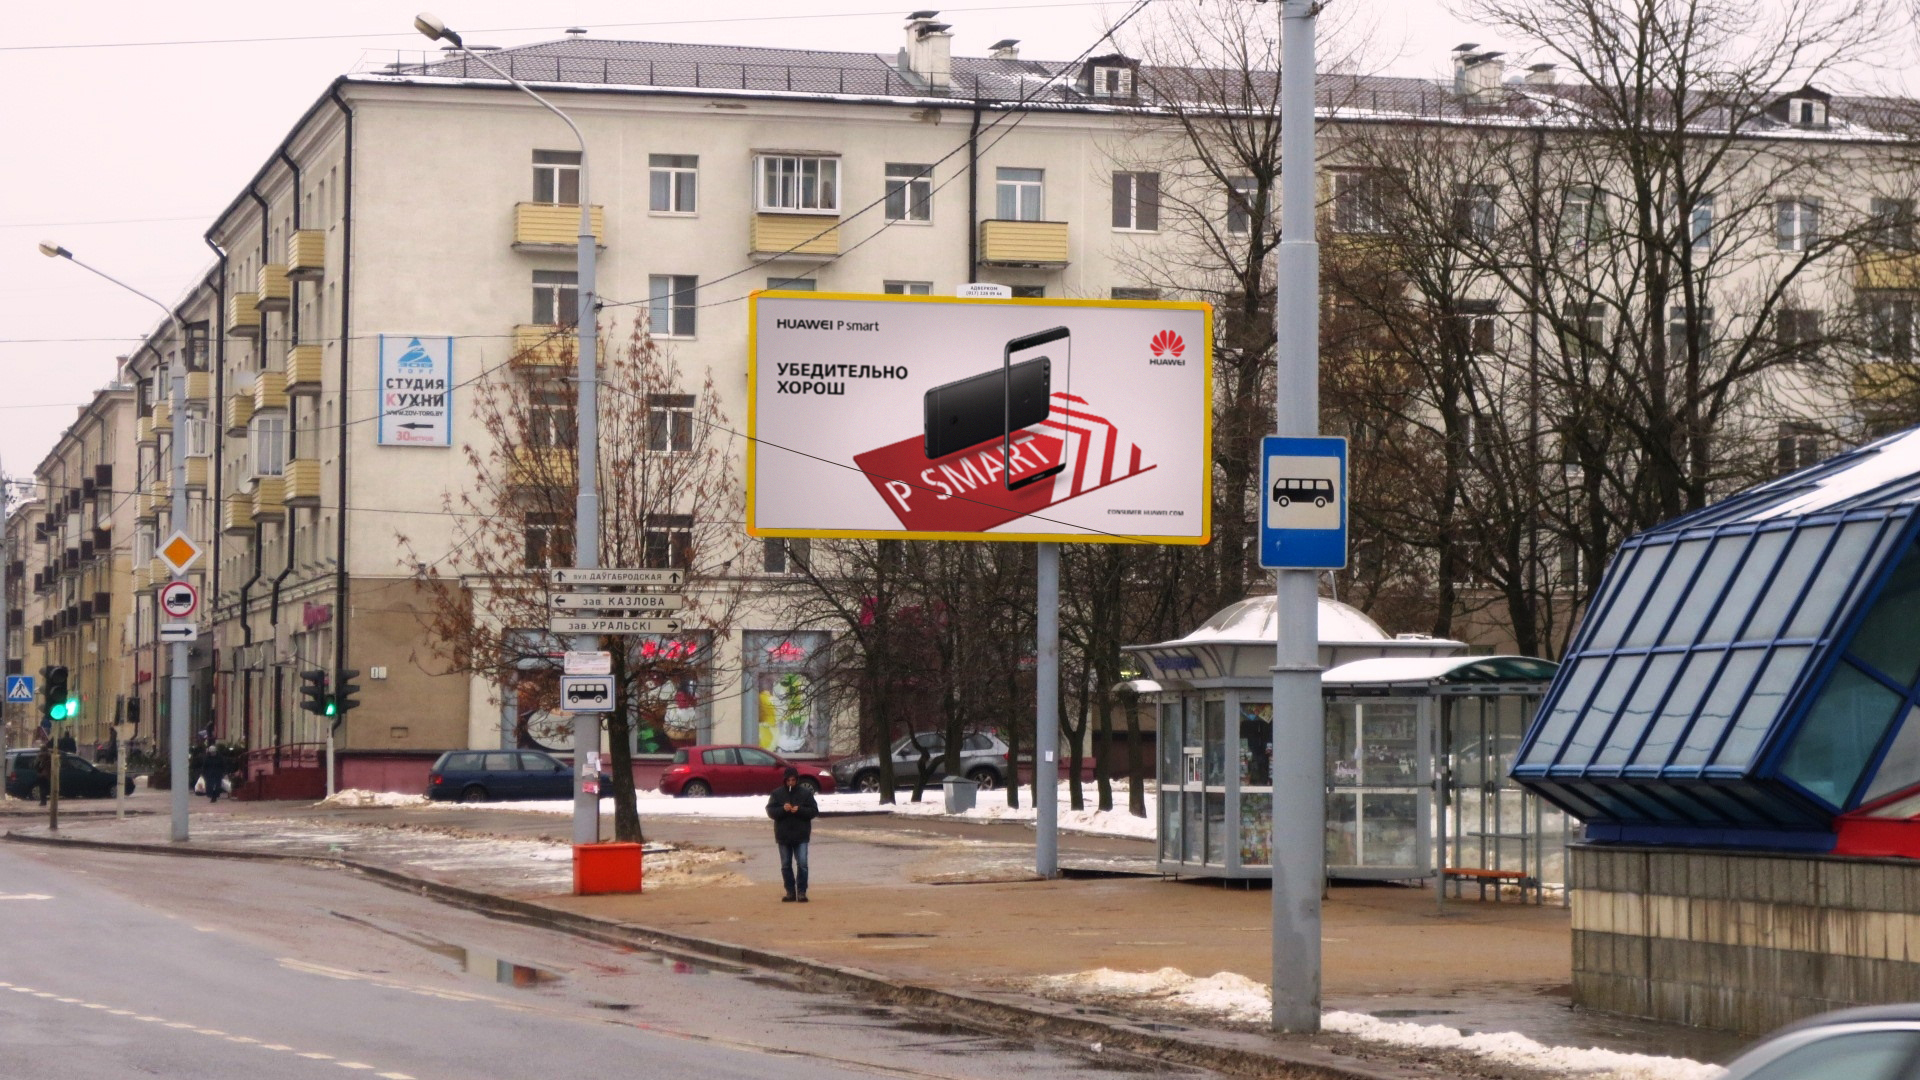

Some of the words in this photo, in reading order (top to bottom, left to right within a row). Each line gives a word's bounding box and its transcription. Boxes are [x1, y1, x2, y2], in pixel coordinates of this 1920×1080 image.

[777, 319, 833, 330] HUAWEI
[837, 321, 845, 330] P
[846, 321, 880, 332] smart
[1149, 359, 1186, 367] HUAWEI
[777, 362, 908, 380] УБЕДИТЕЛЬНО
[386, 378, 444, 391] СТУДИЯ
[777, 380, 845, 395] ХОРОШ
[386, 394, 444, 407] КУХНИ
[396, 431, 411, 441] 30
[885, 479, 912, 512] P
[920, 435, 1050, 500] SMART
[590, 572, 663, 581] ДАЎГАБРОДСКАЯ
[608, 597, 665, 606] КАЗЛОВА
[592, 621, 651, 631] УРАЛЬСКІ
